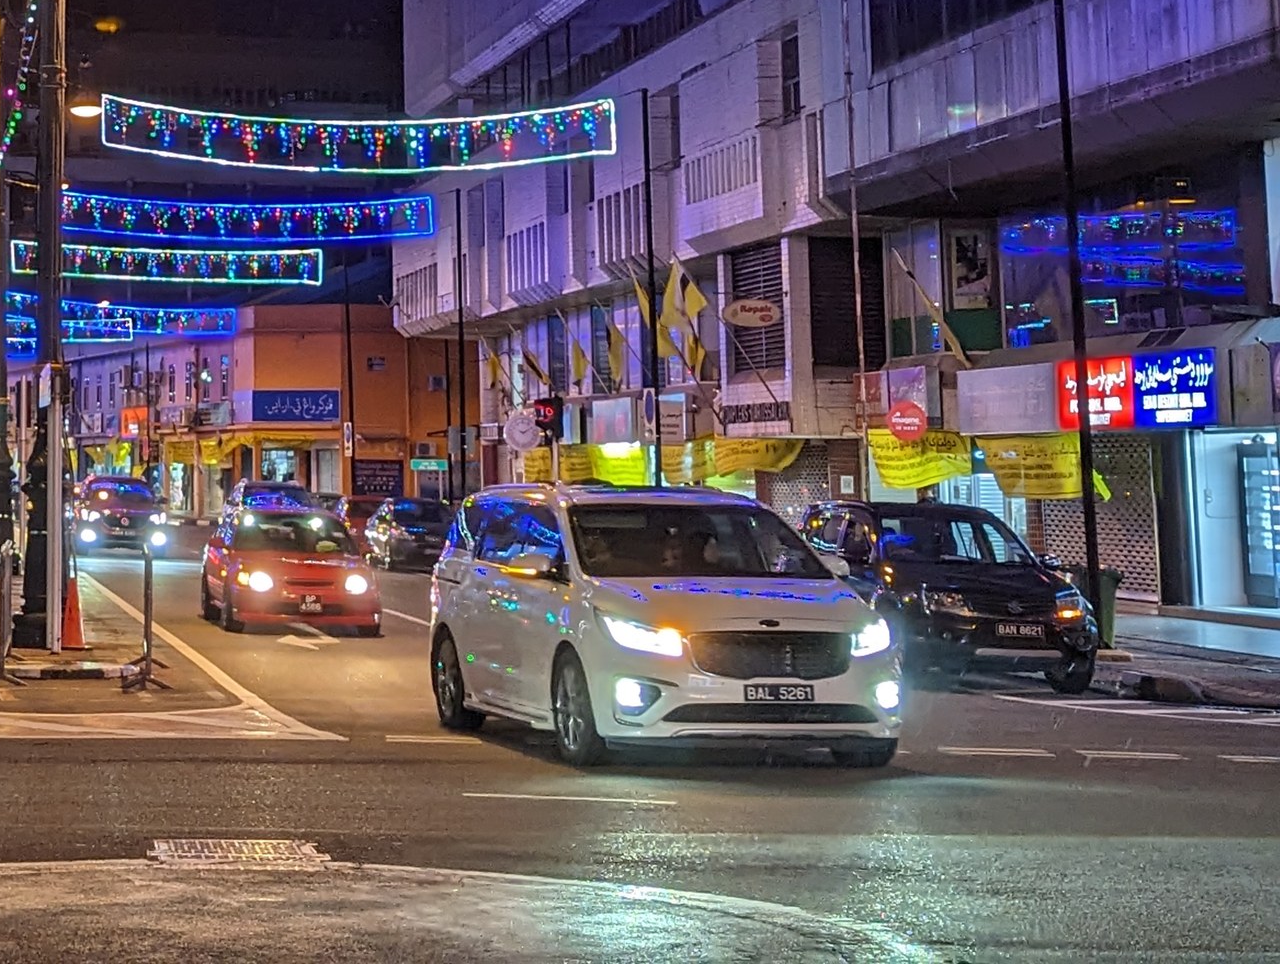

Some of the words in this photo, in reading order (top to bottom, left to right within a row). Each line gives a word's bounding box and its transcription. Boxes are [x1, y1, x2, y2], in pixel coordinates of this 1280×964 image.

[740, 305, 772, 314] Repair
[998, 624, 1017, 635] BAN
[746, 686, 775, 700] BAL
[779, 686, 812, 700] 5261
